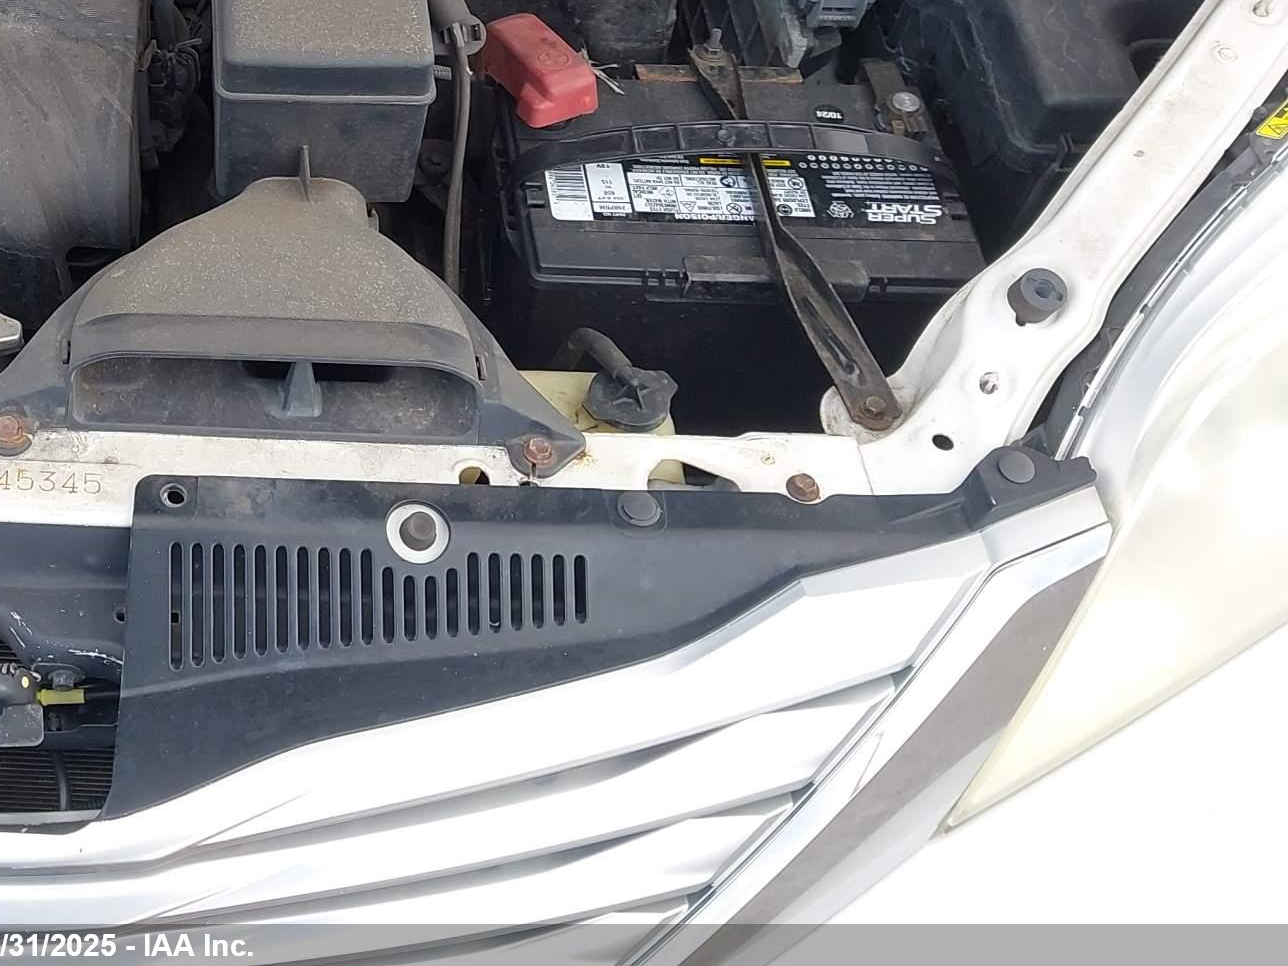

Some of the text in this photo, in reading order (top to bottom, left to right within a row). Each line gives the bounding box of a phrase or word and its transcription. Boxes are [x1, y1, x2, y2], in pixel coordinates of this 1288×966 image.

[816, 111, 843, 120] 10/24
[864, 203, 943, 217] START
[674, 213, 755, 222] ANGER/POISON
[867, 213, 937, 225] SUPER
